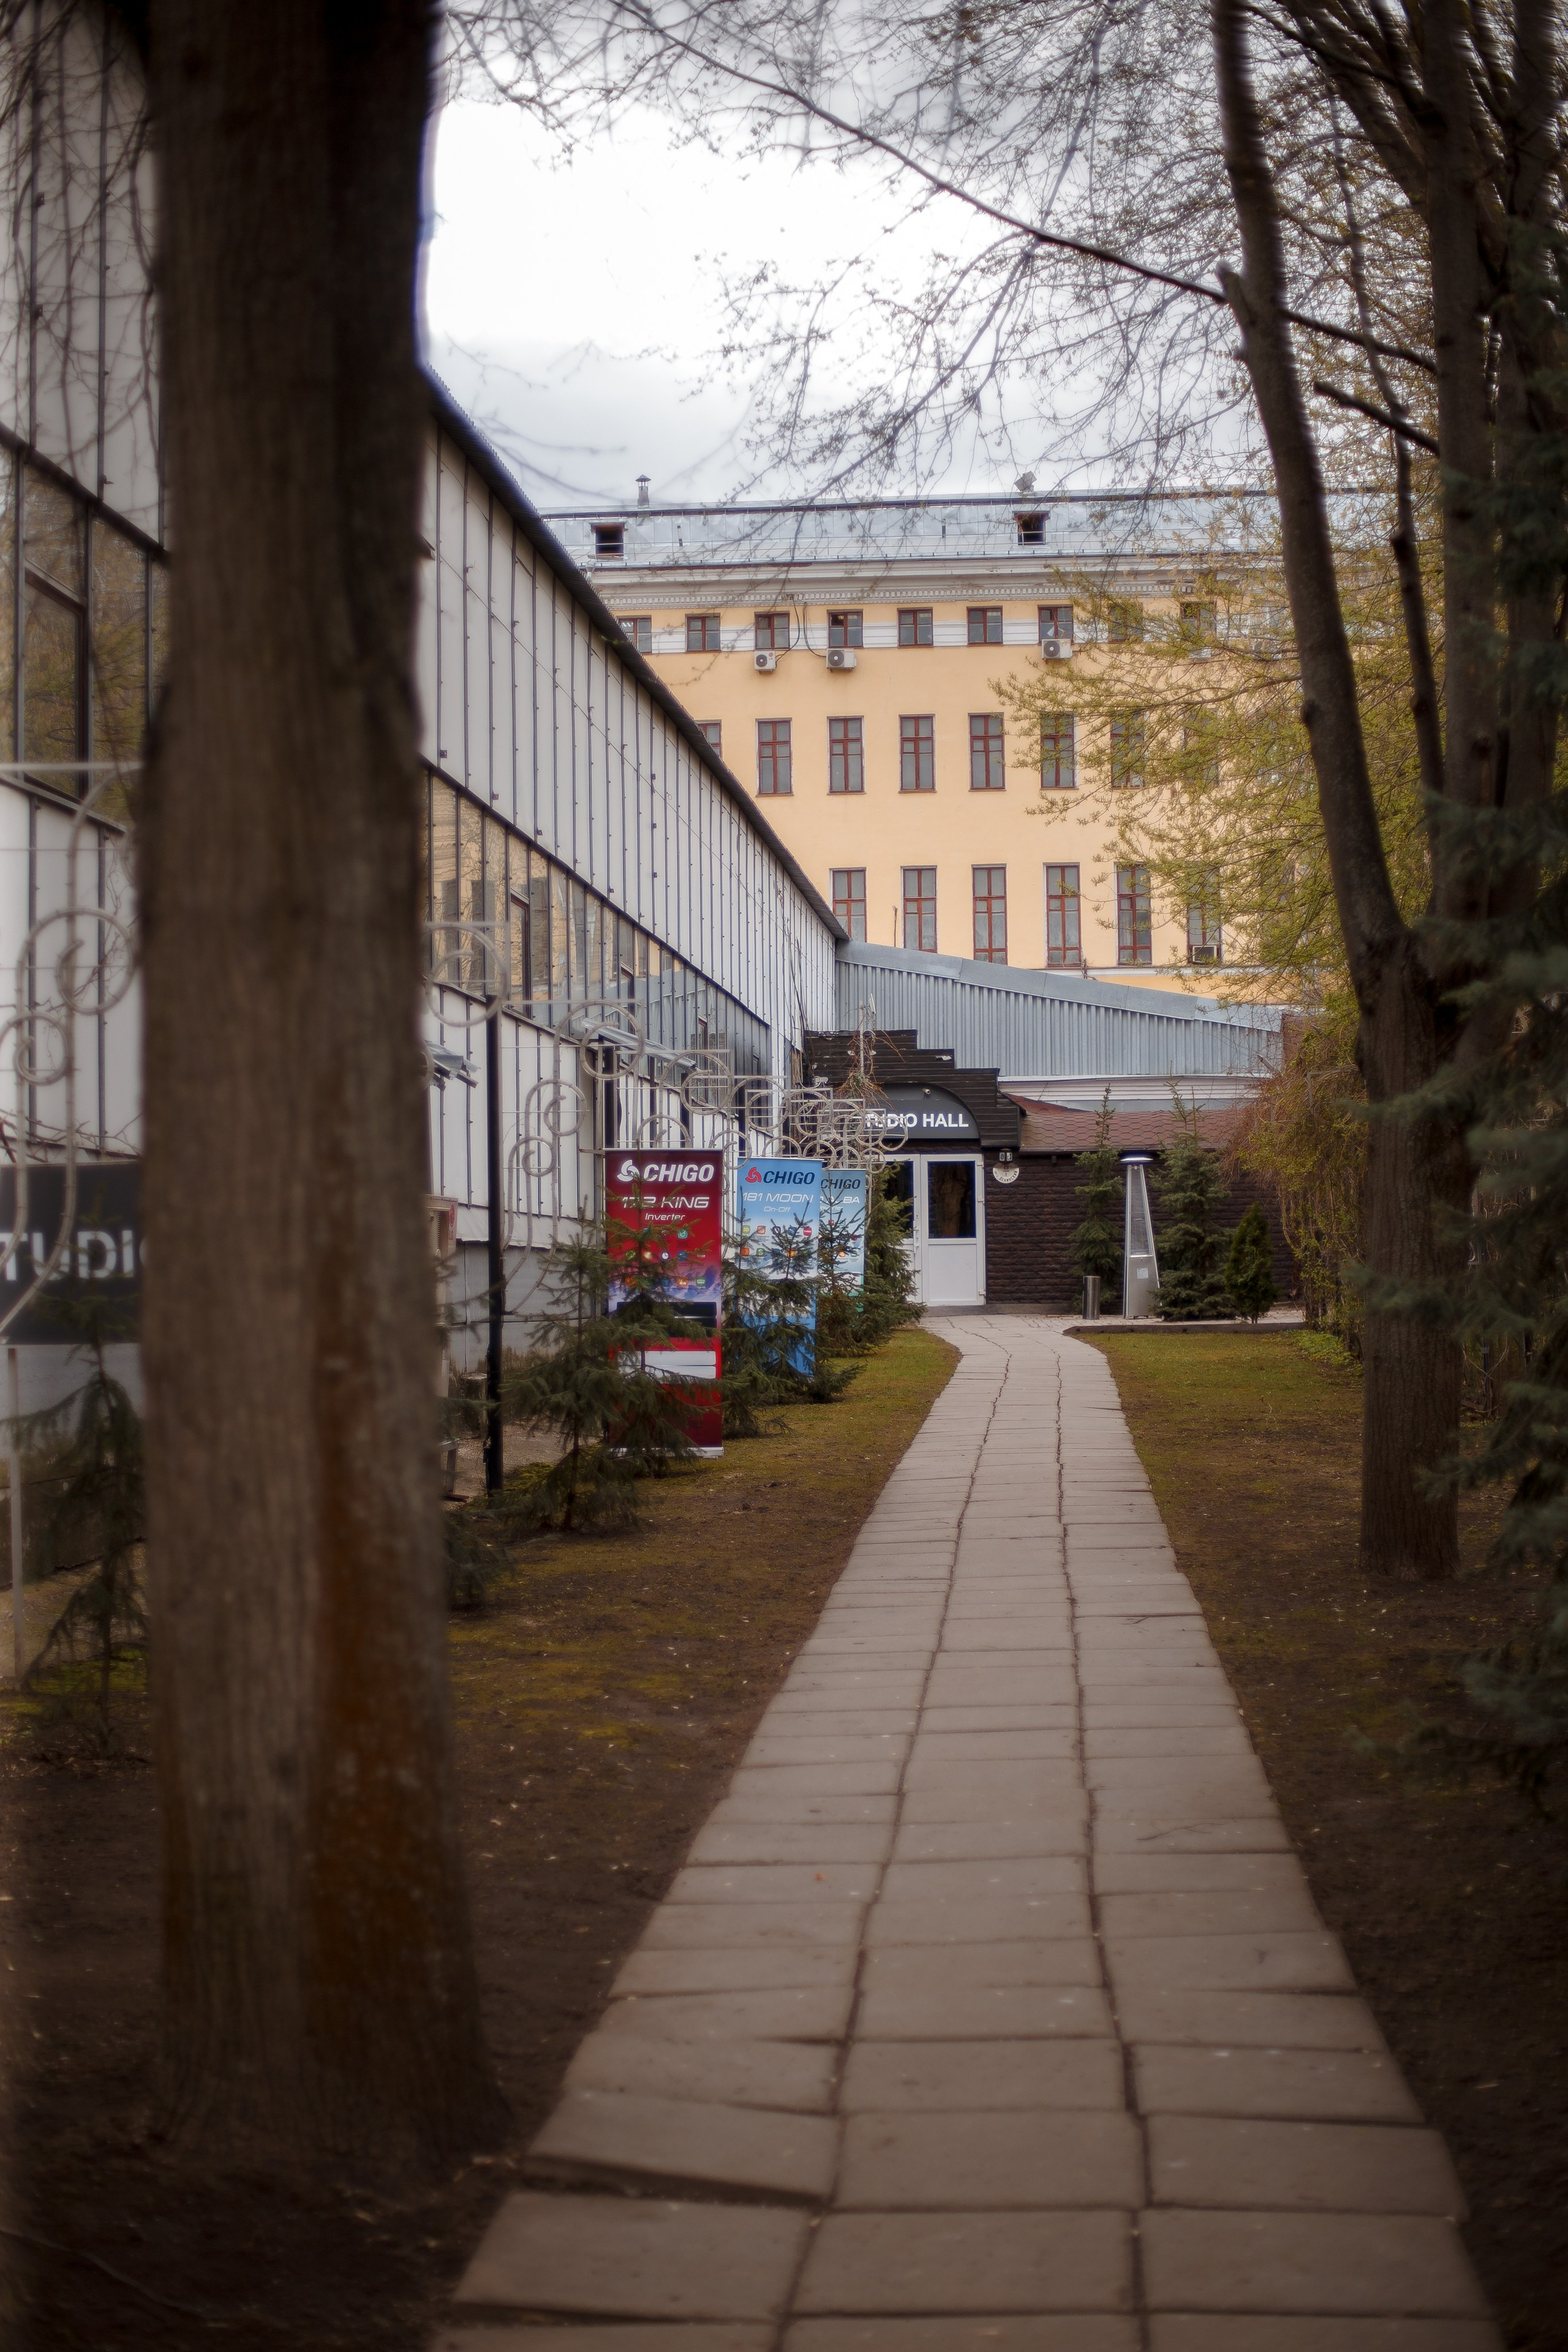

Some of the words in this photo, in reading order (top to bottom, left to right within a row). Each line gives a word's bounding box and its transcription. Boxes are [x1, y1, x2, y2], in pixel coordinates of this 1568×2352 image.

[865, 1113, 918, 1128] TUDIO
[922, 1113, 969, 1128] HALL
[643, 1164, 714, 1182] CHIGO
[763, 1170, 815, 1185] CHIGO
[821, 1178, 861, 1189] CHIGO
[661, 1196, 710, 1208] KING
[742, 1193, 763, 1201] 181
[766, 1193, 814, 1203] MOON
[0, 1230, 151, 1281] TUDI
